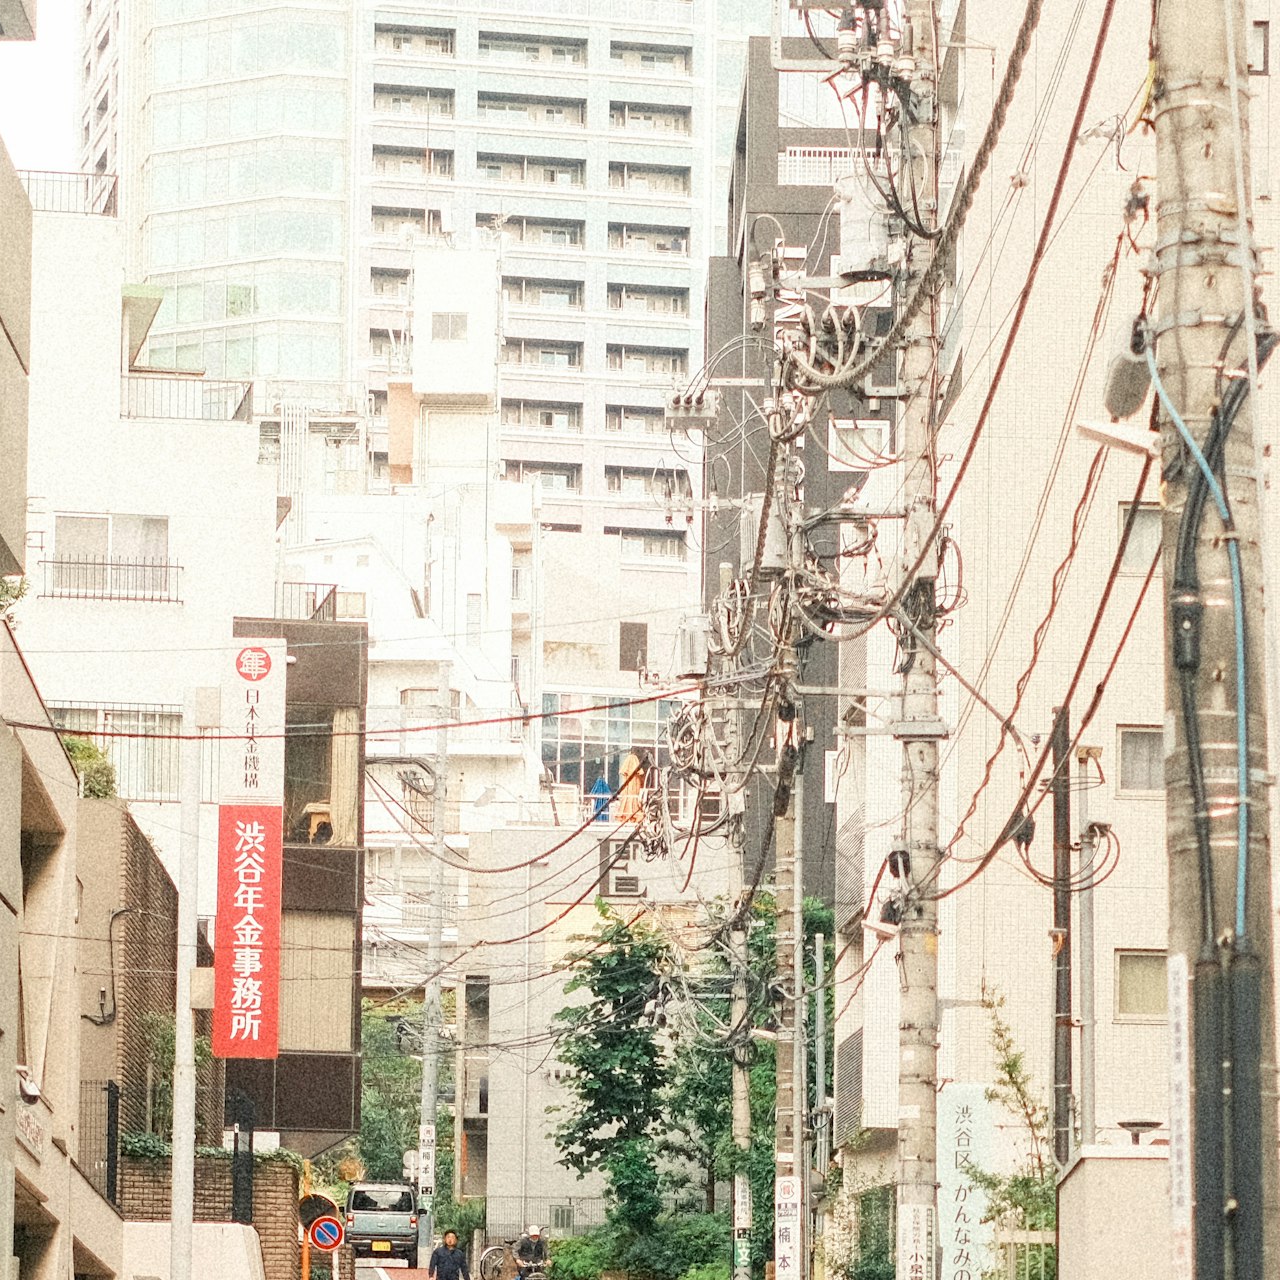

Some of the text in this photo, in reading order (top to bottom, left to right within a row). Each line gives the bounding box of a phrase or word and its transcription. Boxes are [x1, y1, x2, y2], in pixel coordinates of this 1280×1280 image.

[243, 688, 261, 789] 日本年金機構
[229, 821, 266, 1041] 渋谷年金事務所
[954, 1104, 973, 1170] 渋谷区
[778, 1226, 791, 1271] 楠本
